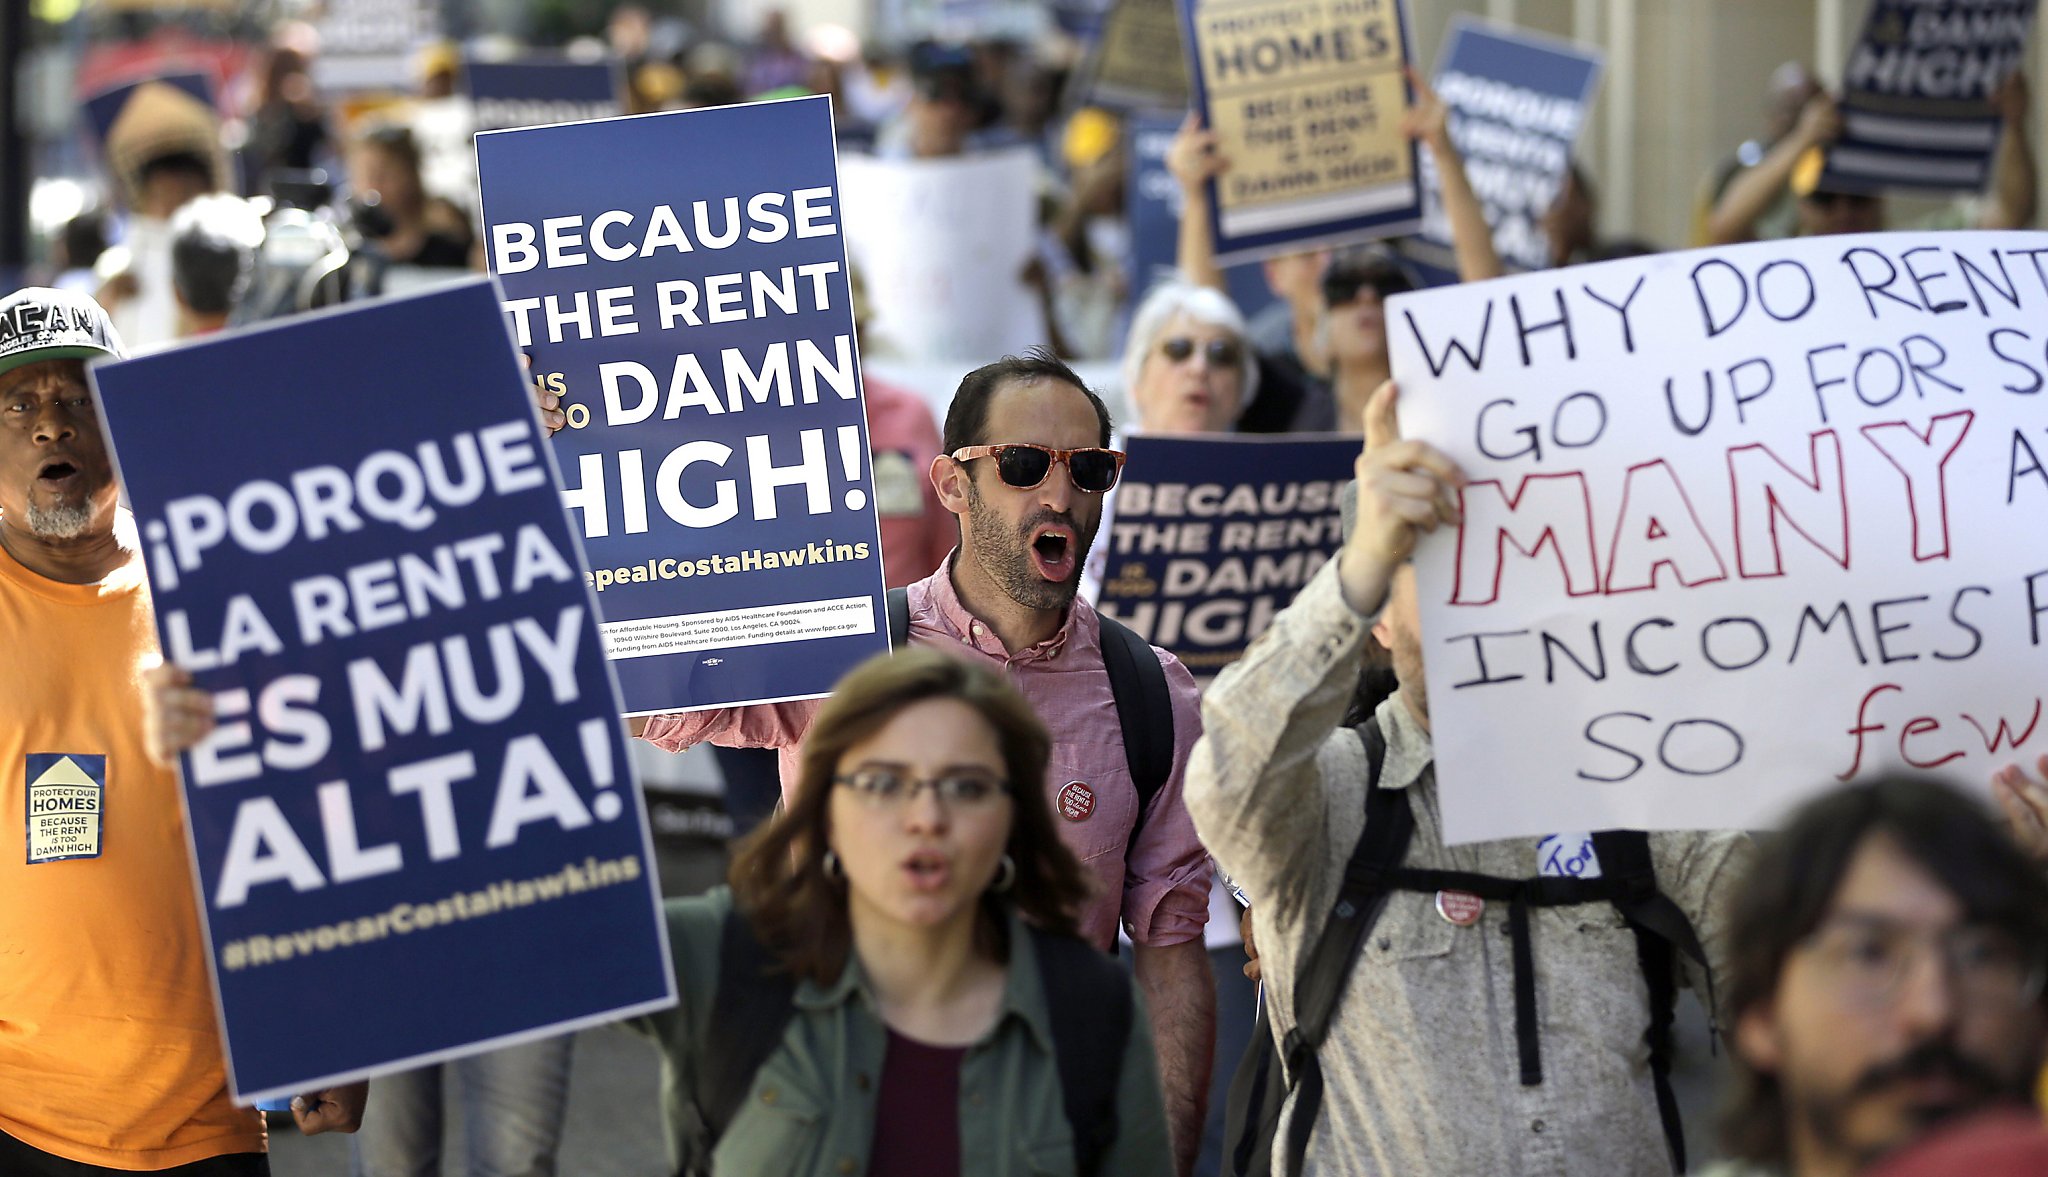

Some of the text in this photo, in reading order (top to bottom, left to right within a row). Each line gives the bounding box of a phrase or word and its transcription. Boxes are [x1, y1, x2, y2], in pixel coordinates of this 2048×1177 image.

[1213, 21, 1391, 79] HOMES
[492, 186, 838, 275] BECAUSE
[501, 261, 841, 347] THE RENT
[1402, 273, 1646, 378] WHY
[1689, 258, 1816, 337] DO
[536, 372, 568, 397] IS
[598, 334, 858, 427] DAMN
[1475, 327, 2048, 462] GO UP FOR S
[145, 418, 548, 593] ¡PORQUE
[560, 425, 868, 539] HIGH!
[1446, 409, 1976, 606] MANY
[586, 538, 871, 592] epealCostaHawkins
[1112, 517, 1343, 555] THE RENT
[165, 523, 576, 672] LA RENTA
[619, 624, 652, 633] Affordable
[681, 617, 715, 628] Sponsored
[715, 616, 724, 624] by
[741, 611, 776, 621] Healthcare
[776, 608, 812, 617] Foundation
[826, 604, 844, 612] ACCE
[633, 633, 659, 641] Wilshire
[1444, 585, 1992, 689] INCOMES
[616, 644, 641, 653] funding
[674, 638, 709, 646] Healthcare
[747, 631, 774, 640] Funding
[775, 629, 796, 637] details
[191, 604, 585, 788] ES MUY
[1577, 682, 2041, 783] SO few
[33, 797, 96, 813] HOMES
[34, 788, 97, 798] PROTECT OUR
[40, 817, 88, 827] BECAUSE
[40, 826, 88, 837] THE RENT
[214, 716, 624, 910] ALTA!
[36, 843, 92, 856] DAMN HIGH
[51, 835, 78, 844] IS TOO
[221, 853, 641, 971] #RevocarCostaHawkins
